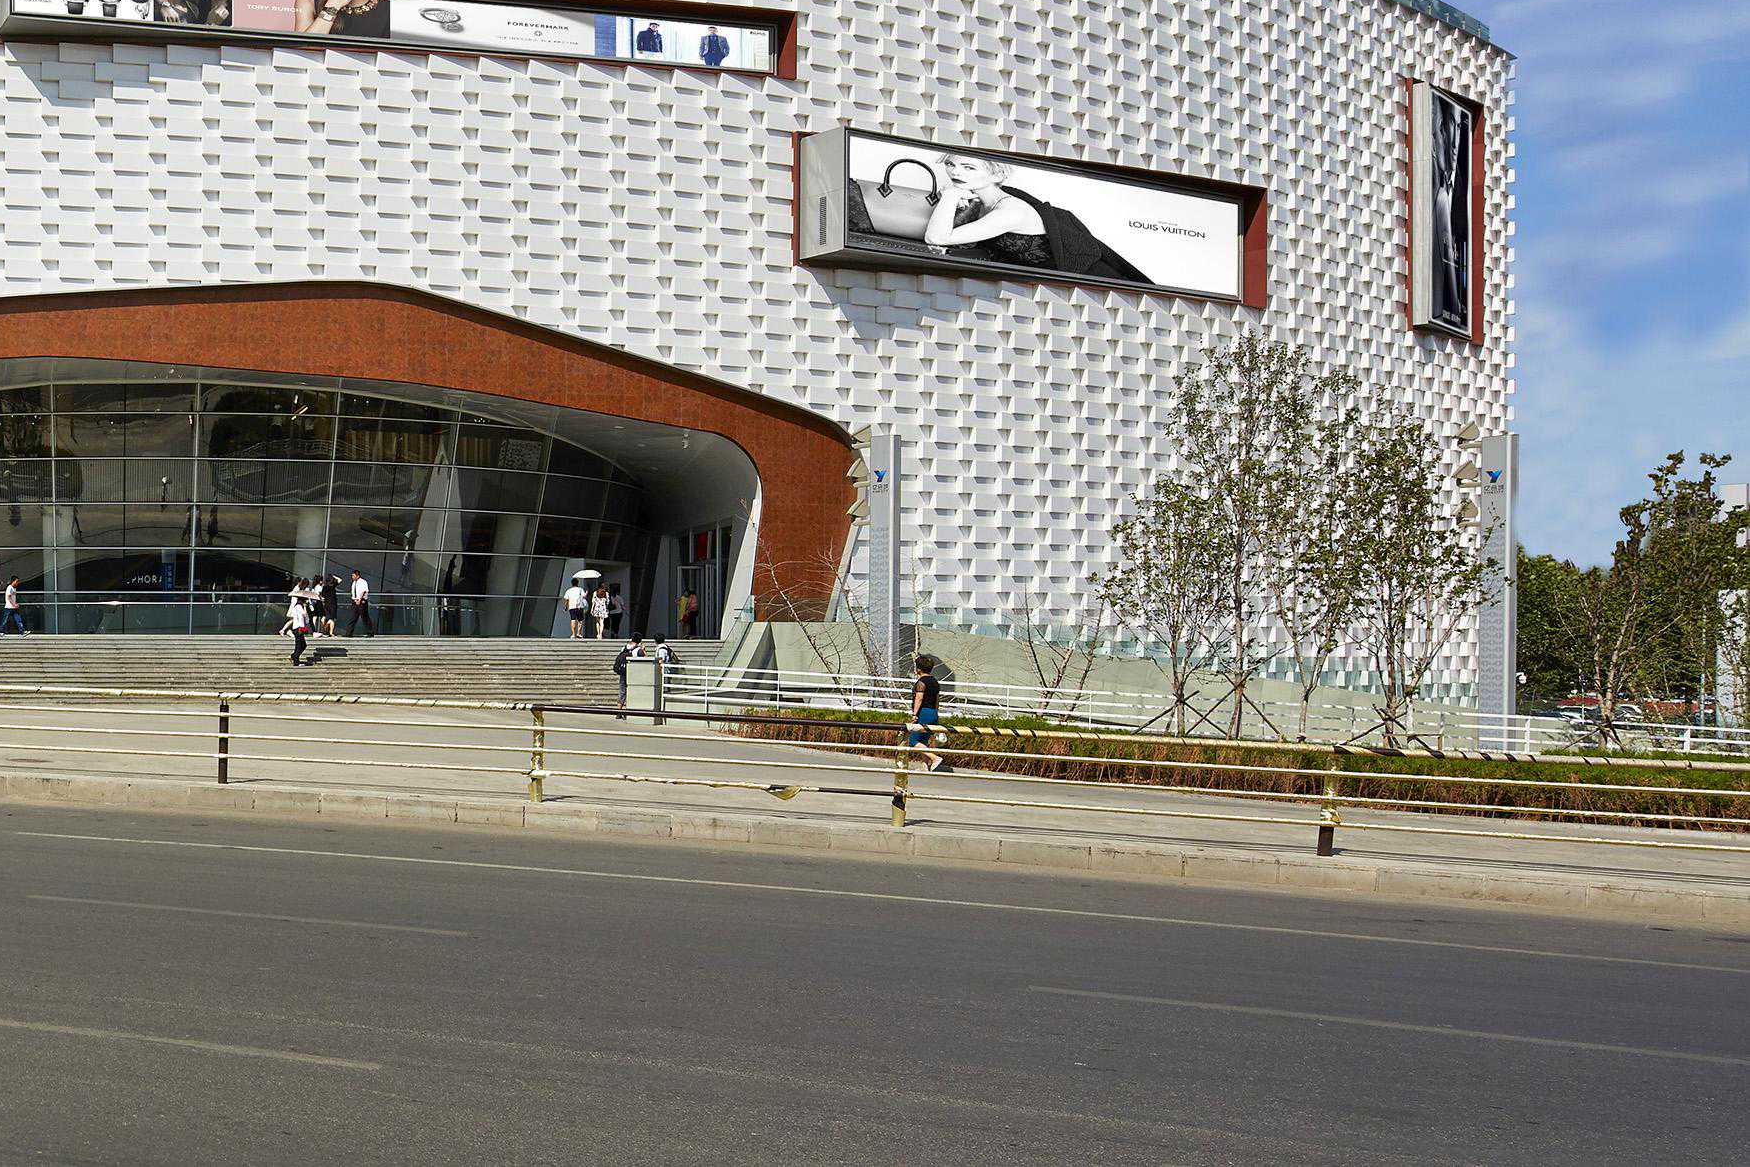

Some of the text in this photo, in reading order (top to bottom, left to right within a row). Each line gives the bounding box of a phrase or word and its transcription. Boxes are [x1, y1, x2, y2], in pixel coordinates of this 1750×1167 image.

[507, 21, 569, 31] FOREVERMARK
[1128, 220, 1159, 231] LOUIS
[1161, 225, 1206, 239] VUITTON
